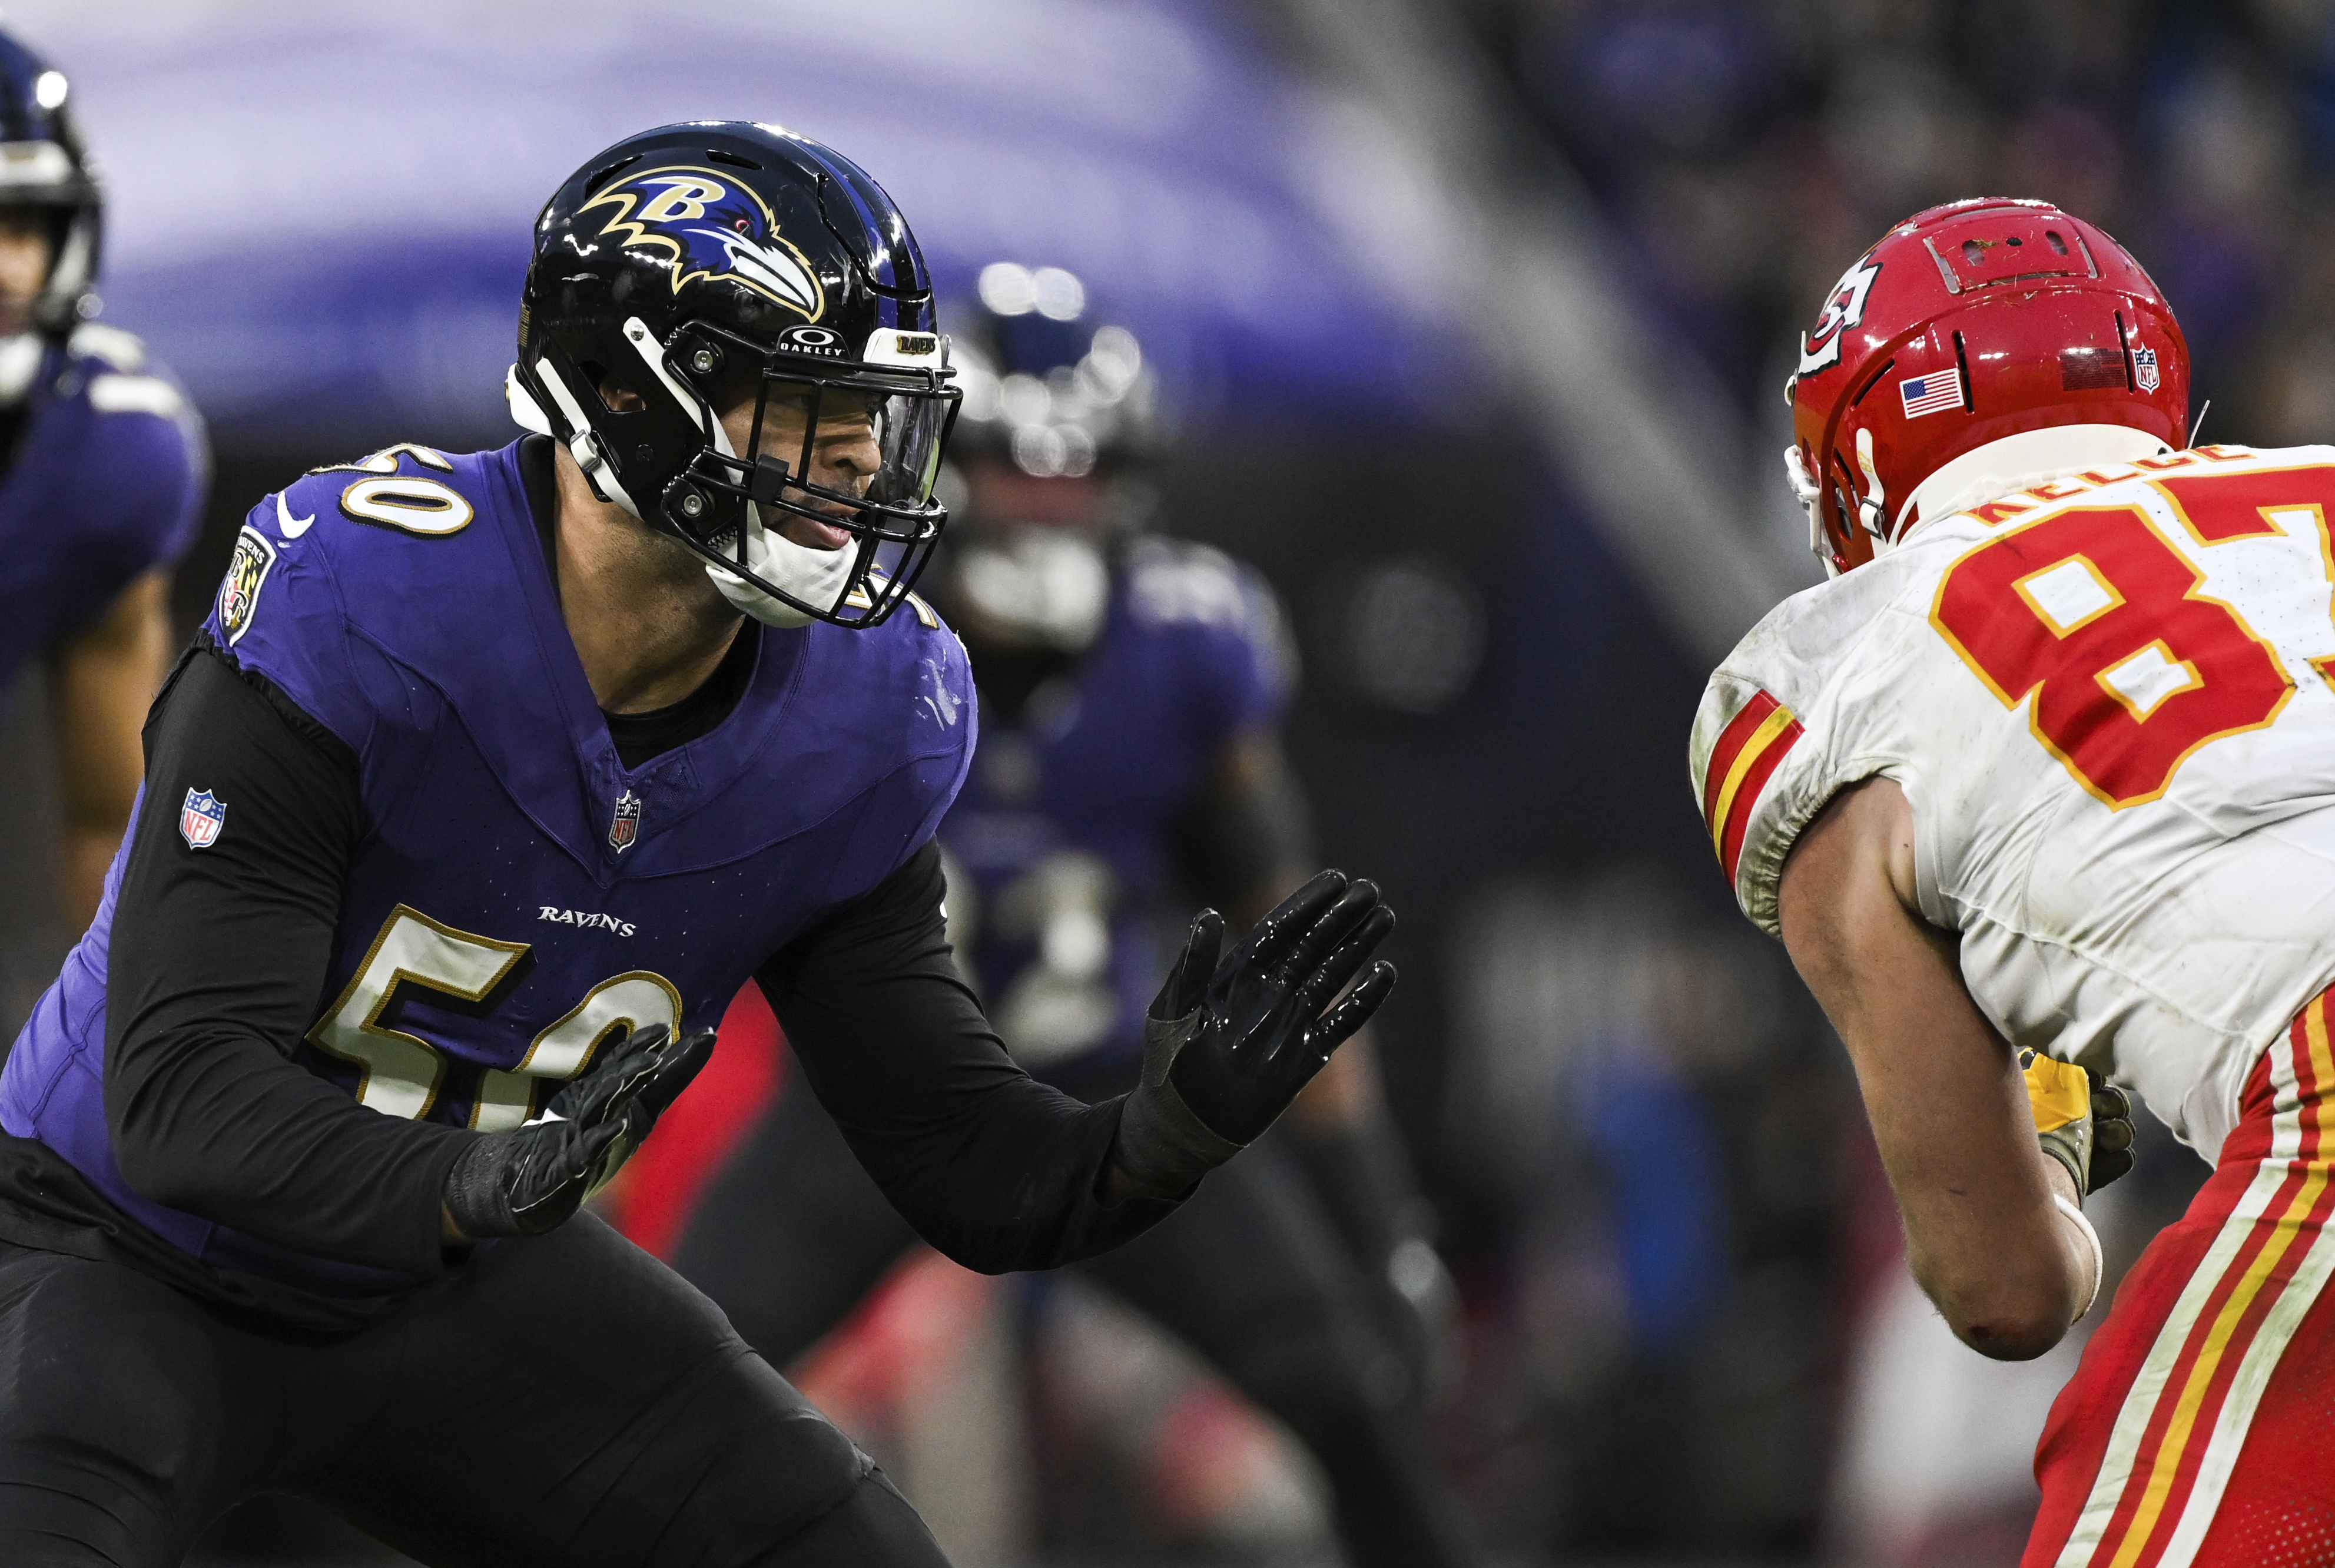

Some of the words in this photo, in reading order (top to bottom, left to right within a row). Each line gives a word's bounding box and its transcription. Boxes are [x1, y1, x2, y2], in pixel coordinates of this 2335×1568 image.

[780, 342, 843, 356] OAKLEY
[898, 335, 936, 354] RAVENS
[2139, 366, 2157, 385] NFL
[237, 536, 265, 564] AVENS
[184, 810, 214, 841] NFL
[613, 820, 633, 843] NFL
[536, 906, 637, 937] RAVENS
